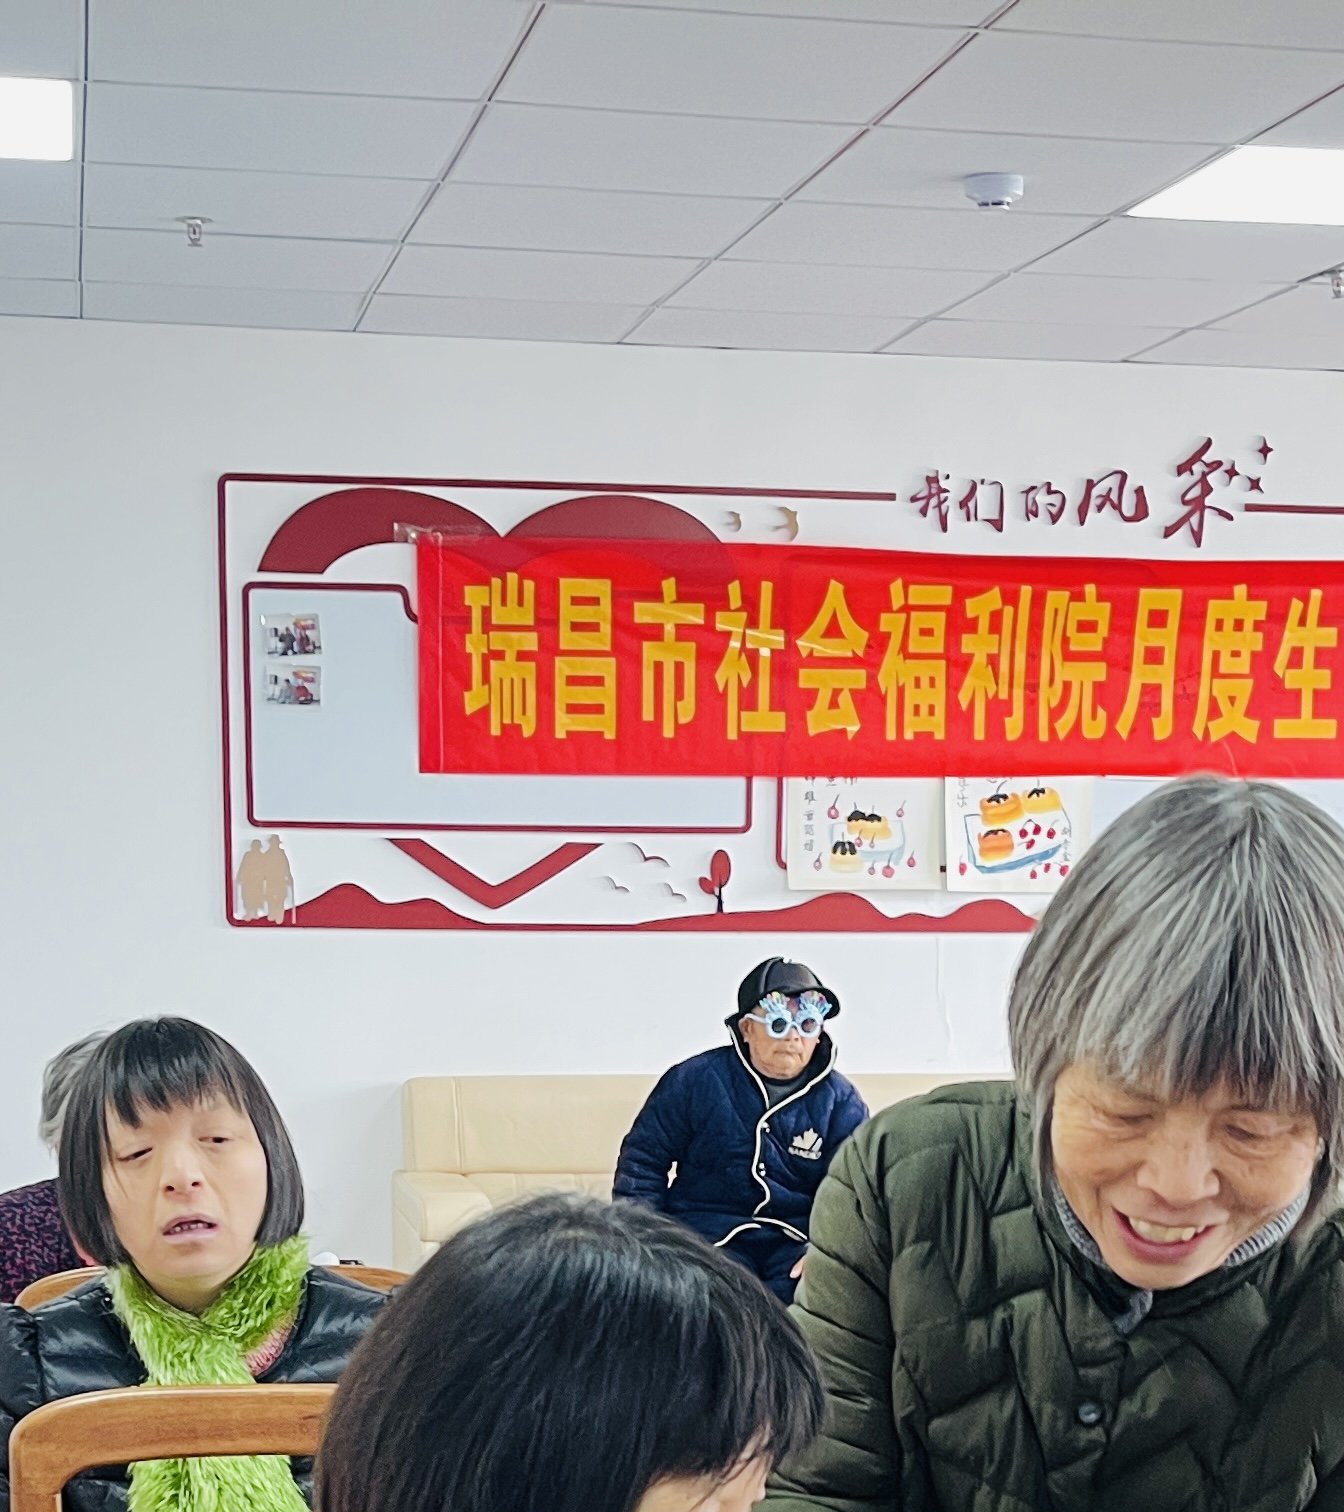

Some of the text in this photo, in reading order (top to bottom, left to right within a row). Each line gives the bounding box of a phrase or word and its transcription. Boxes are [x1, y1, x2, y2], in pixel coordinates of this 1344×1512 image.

[909, 437, 1236, 548] 我们的风采
